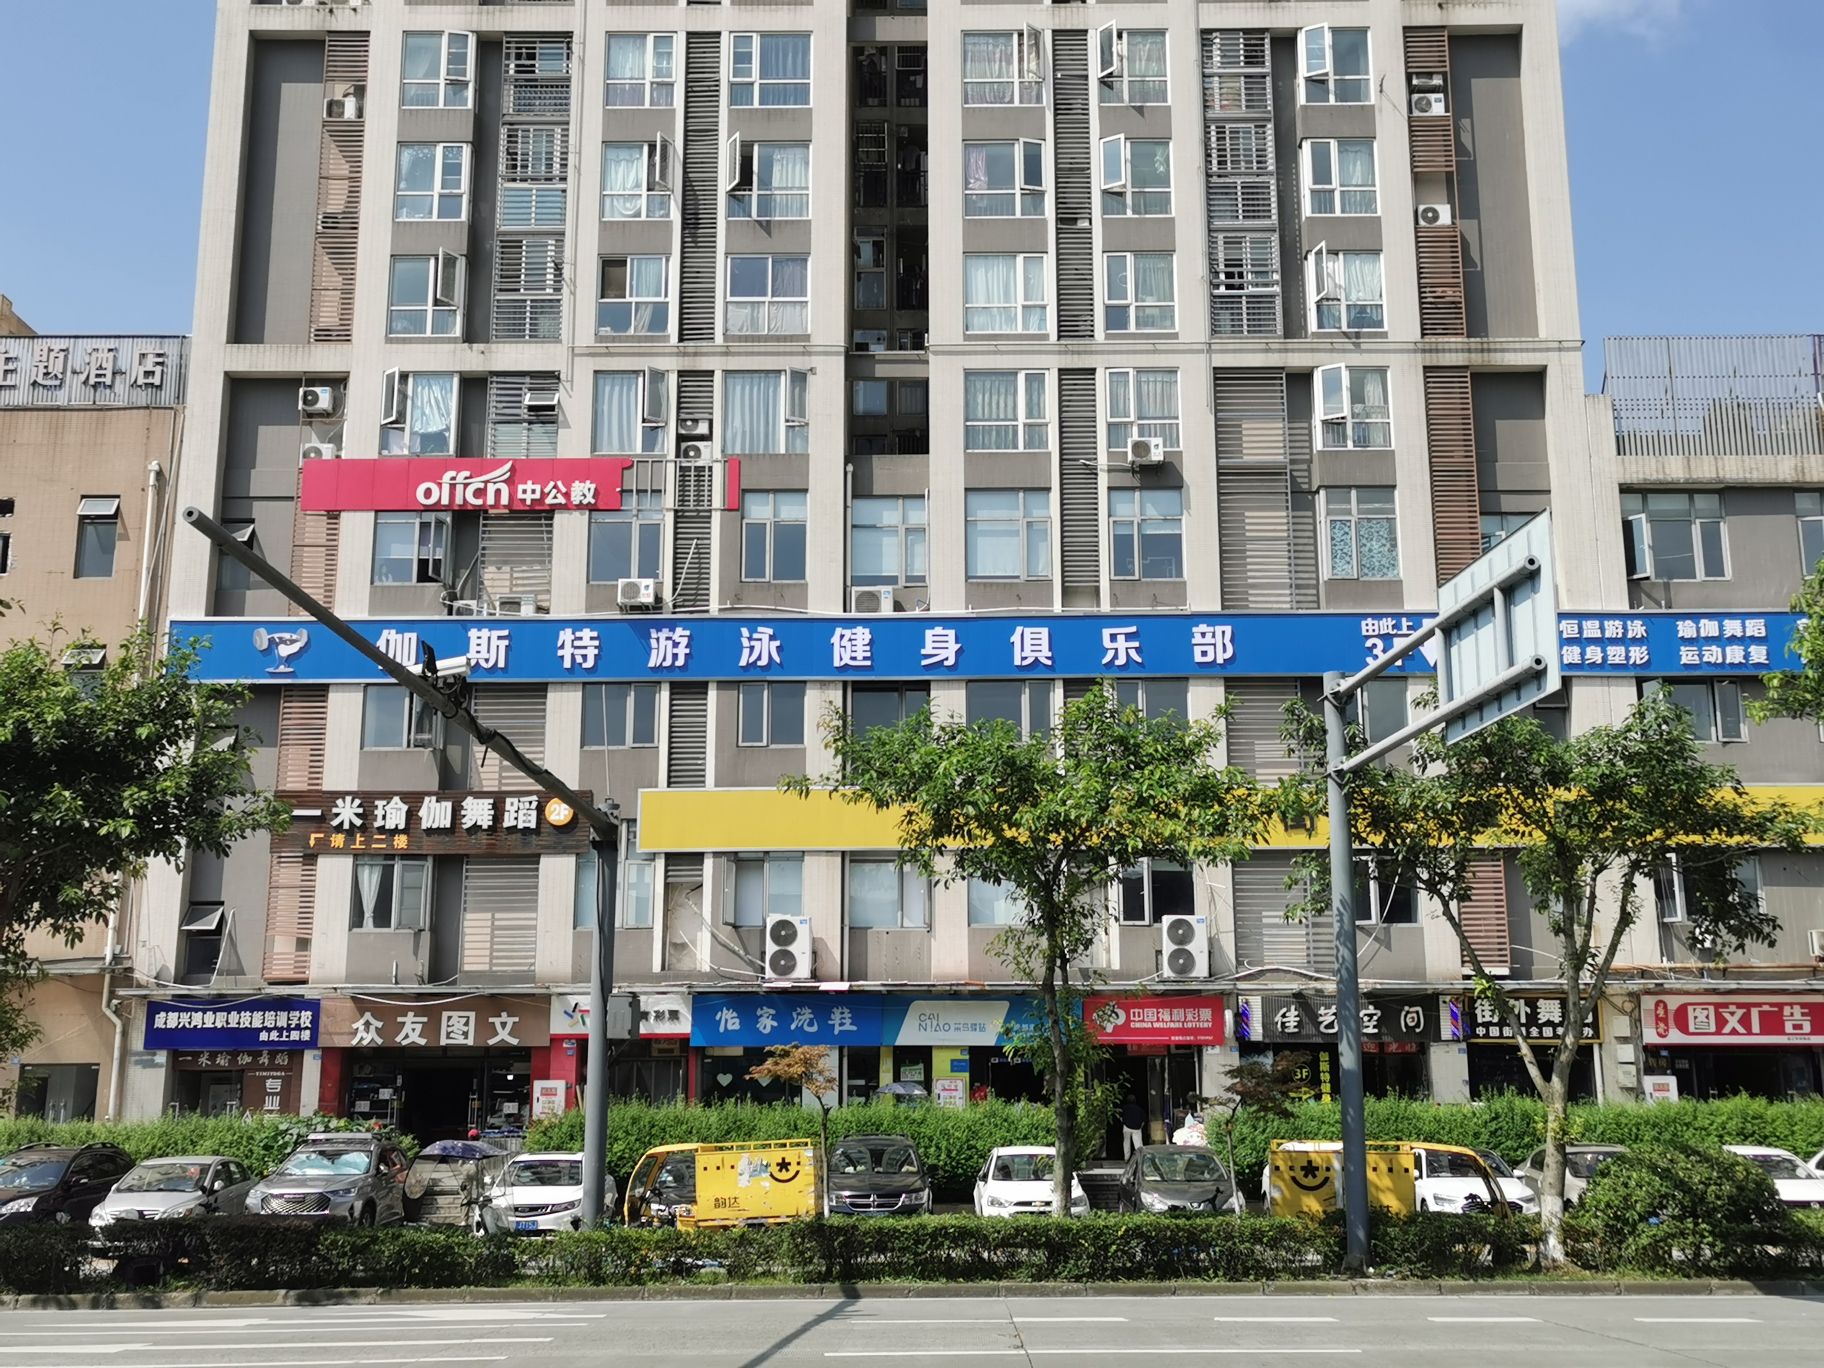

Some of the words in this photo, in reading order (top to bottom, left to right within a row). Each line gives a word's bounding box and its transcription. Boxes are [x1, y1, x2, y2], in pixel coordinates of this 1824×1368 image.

[416, 461, 512, 506] offcn
[517, 480, 596, 505] 中公教
[1361, 617, 1415, 635] 由此上
[1559, 619, 1648, 639] 恒温游泳
[1676, 618, 1767, 638] 瑜伽舞蹈
[377, 624, 1234, 671] 伽斯特游泳健身俱乐部
[1561, 645, 1649, 666] 健身塑形
[1679, 645, 1769, 665] 运动康复
[291, 795, 539, 830] 一米瑜伽舞蹈
[550, 804, 570, 820] 2F
[715, 1005, 858, 1036] 怡家洗鞋
[1130, 1008, 1213, 1022] 中国福利彩票
[1274, 1004, 1425, 1034] 佳艺空间
[1687, 1004, 1812, 1035] 图文广告
[259, 1029, 311, 1042] 由此上四楼
[350, 1011, 520, 1047] 众友图文
[1294, 1068, 1309, 1080] 3F
[263, 1077, 283, 1116] 专业
[714, 1196, 741, 1209] 韵达
